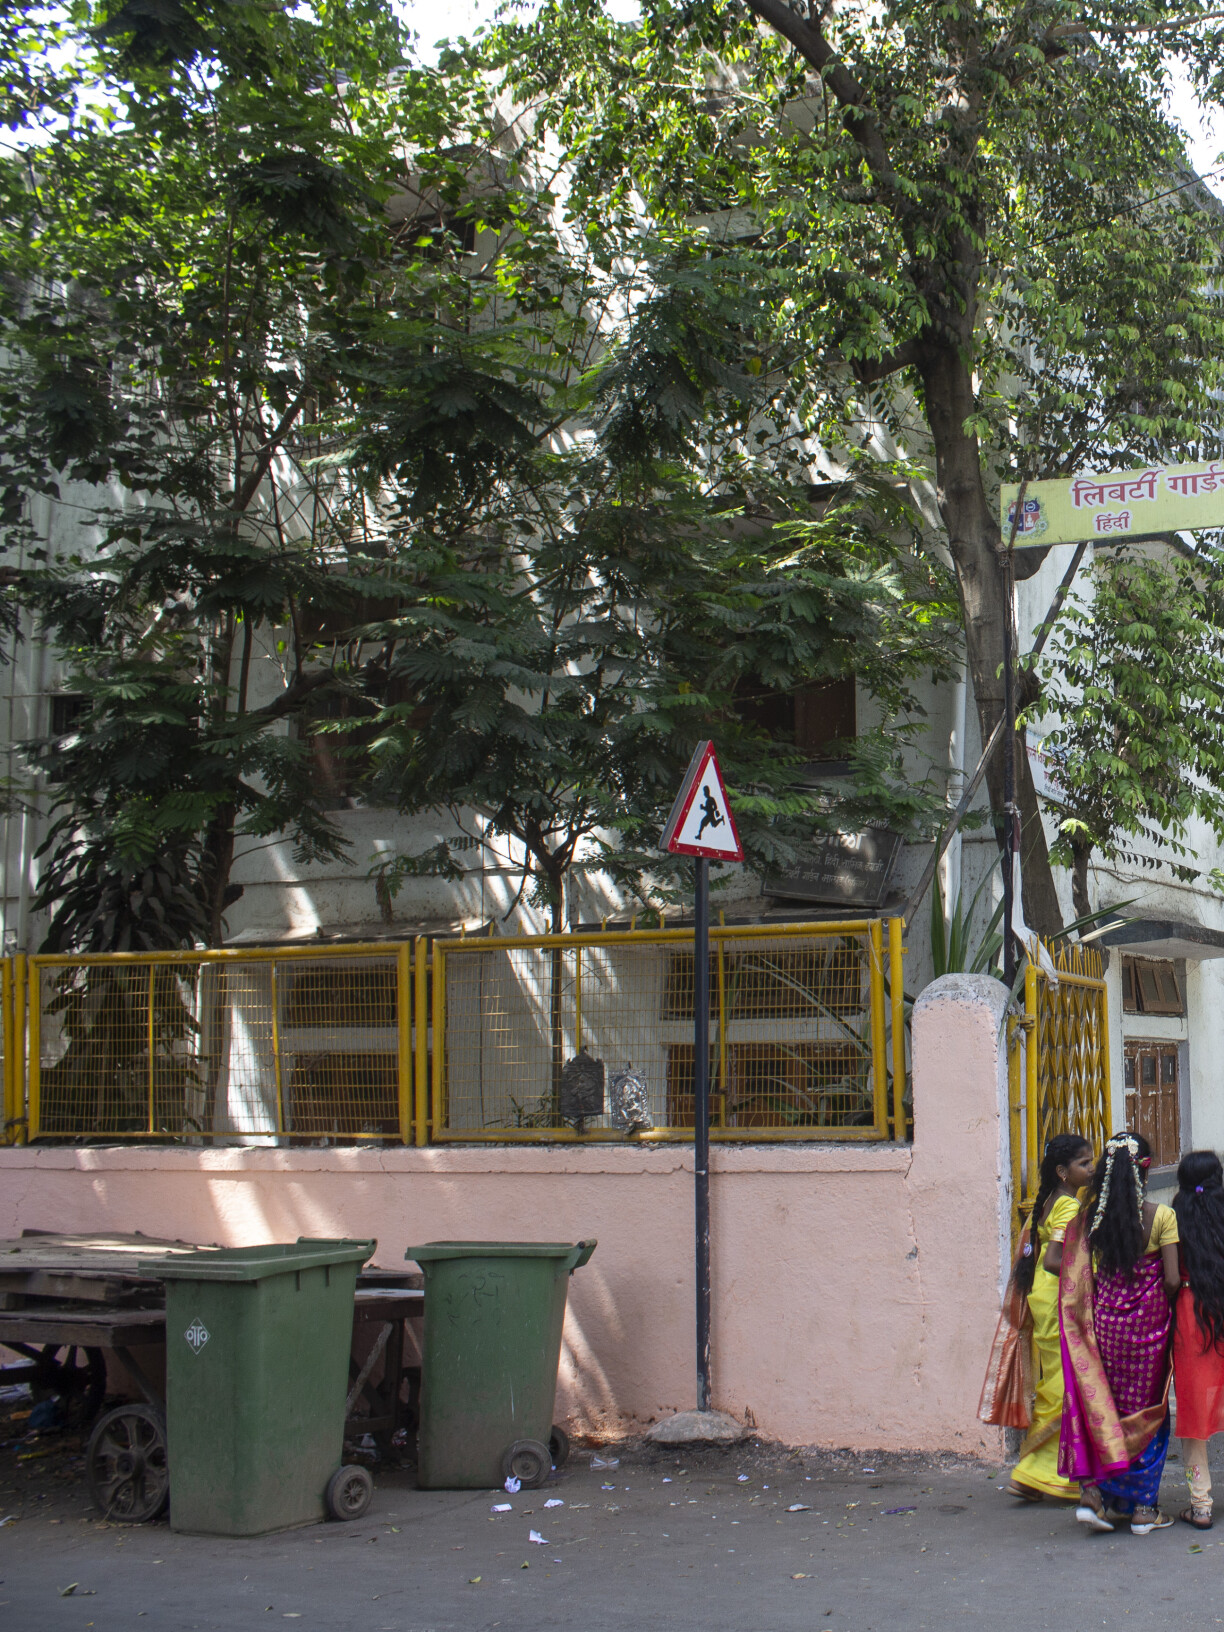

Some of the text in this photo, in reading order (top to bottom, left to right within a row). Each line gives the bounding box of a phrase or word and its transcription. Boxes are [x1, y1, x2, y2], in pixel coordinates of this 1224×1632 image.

[1072, 469, 1164, 507] लिबर्टी
[1095, 511, 1130, 532] हिंदी
[186, 1325, 208, 1347] OTTO
